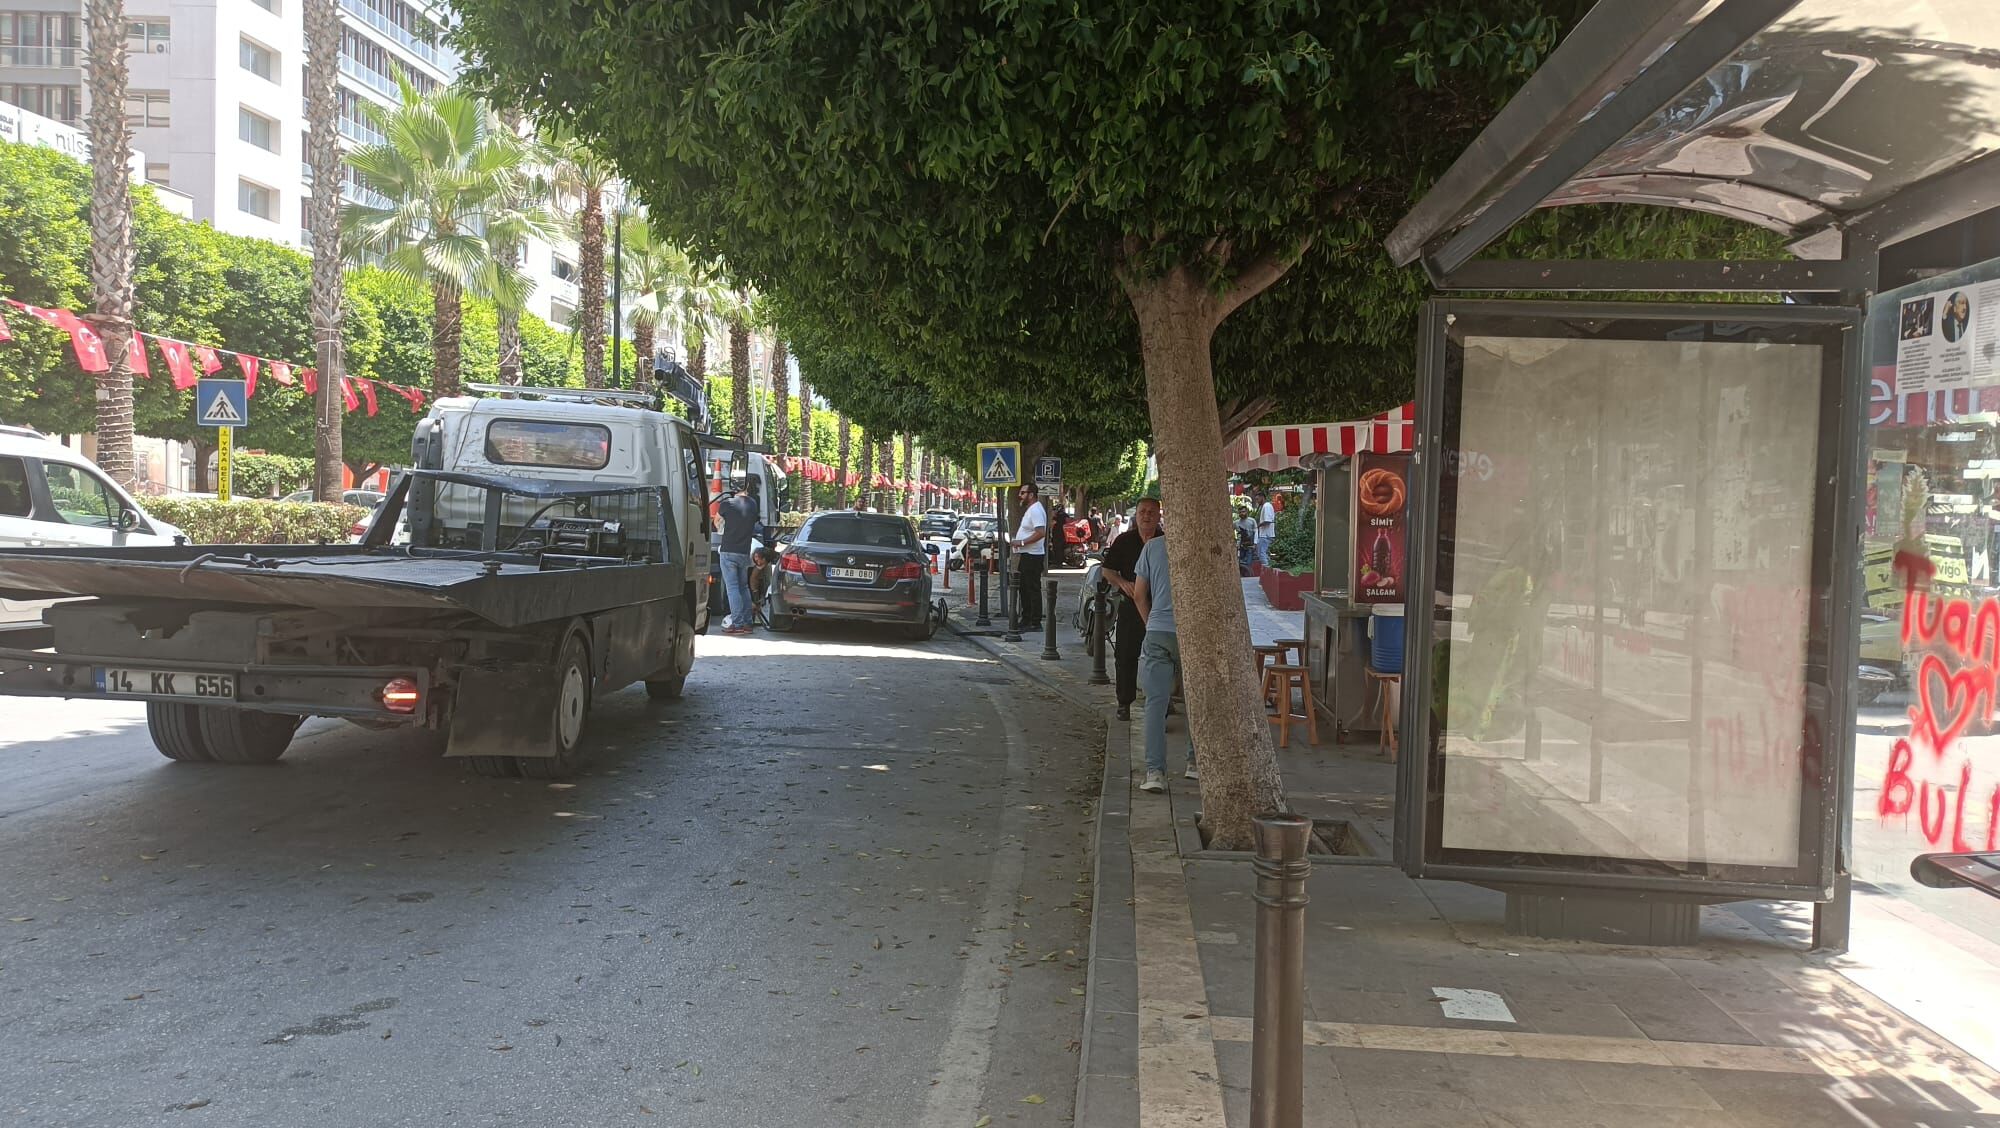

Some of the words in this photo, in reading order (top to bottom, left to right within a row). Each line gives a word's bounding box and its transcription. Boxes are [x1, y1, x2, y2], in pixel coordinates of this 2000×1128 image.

[1370, 516, 1394, 527] SİMİT
[1936, 561, 1961, 579] vigo
[1366, 588, 1396, 598] ŞALGAM
[110, 670, 133, 693] 14
[150, 672, 177, 695] KK
[195, 674, 233, 698] 656
